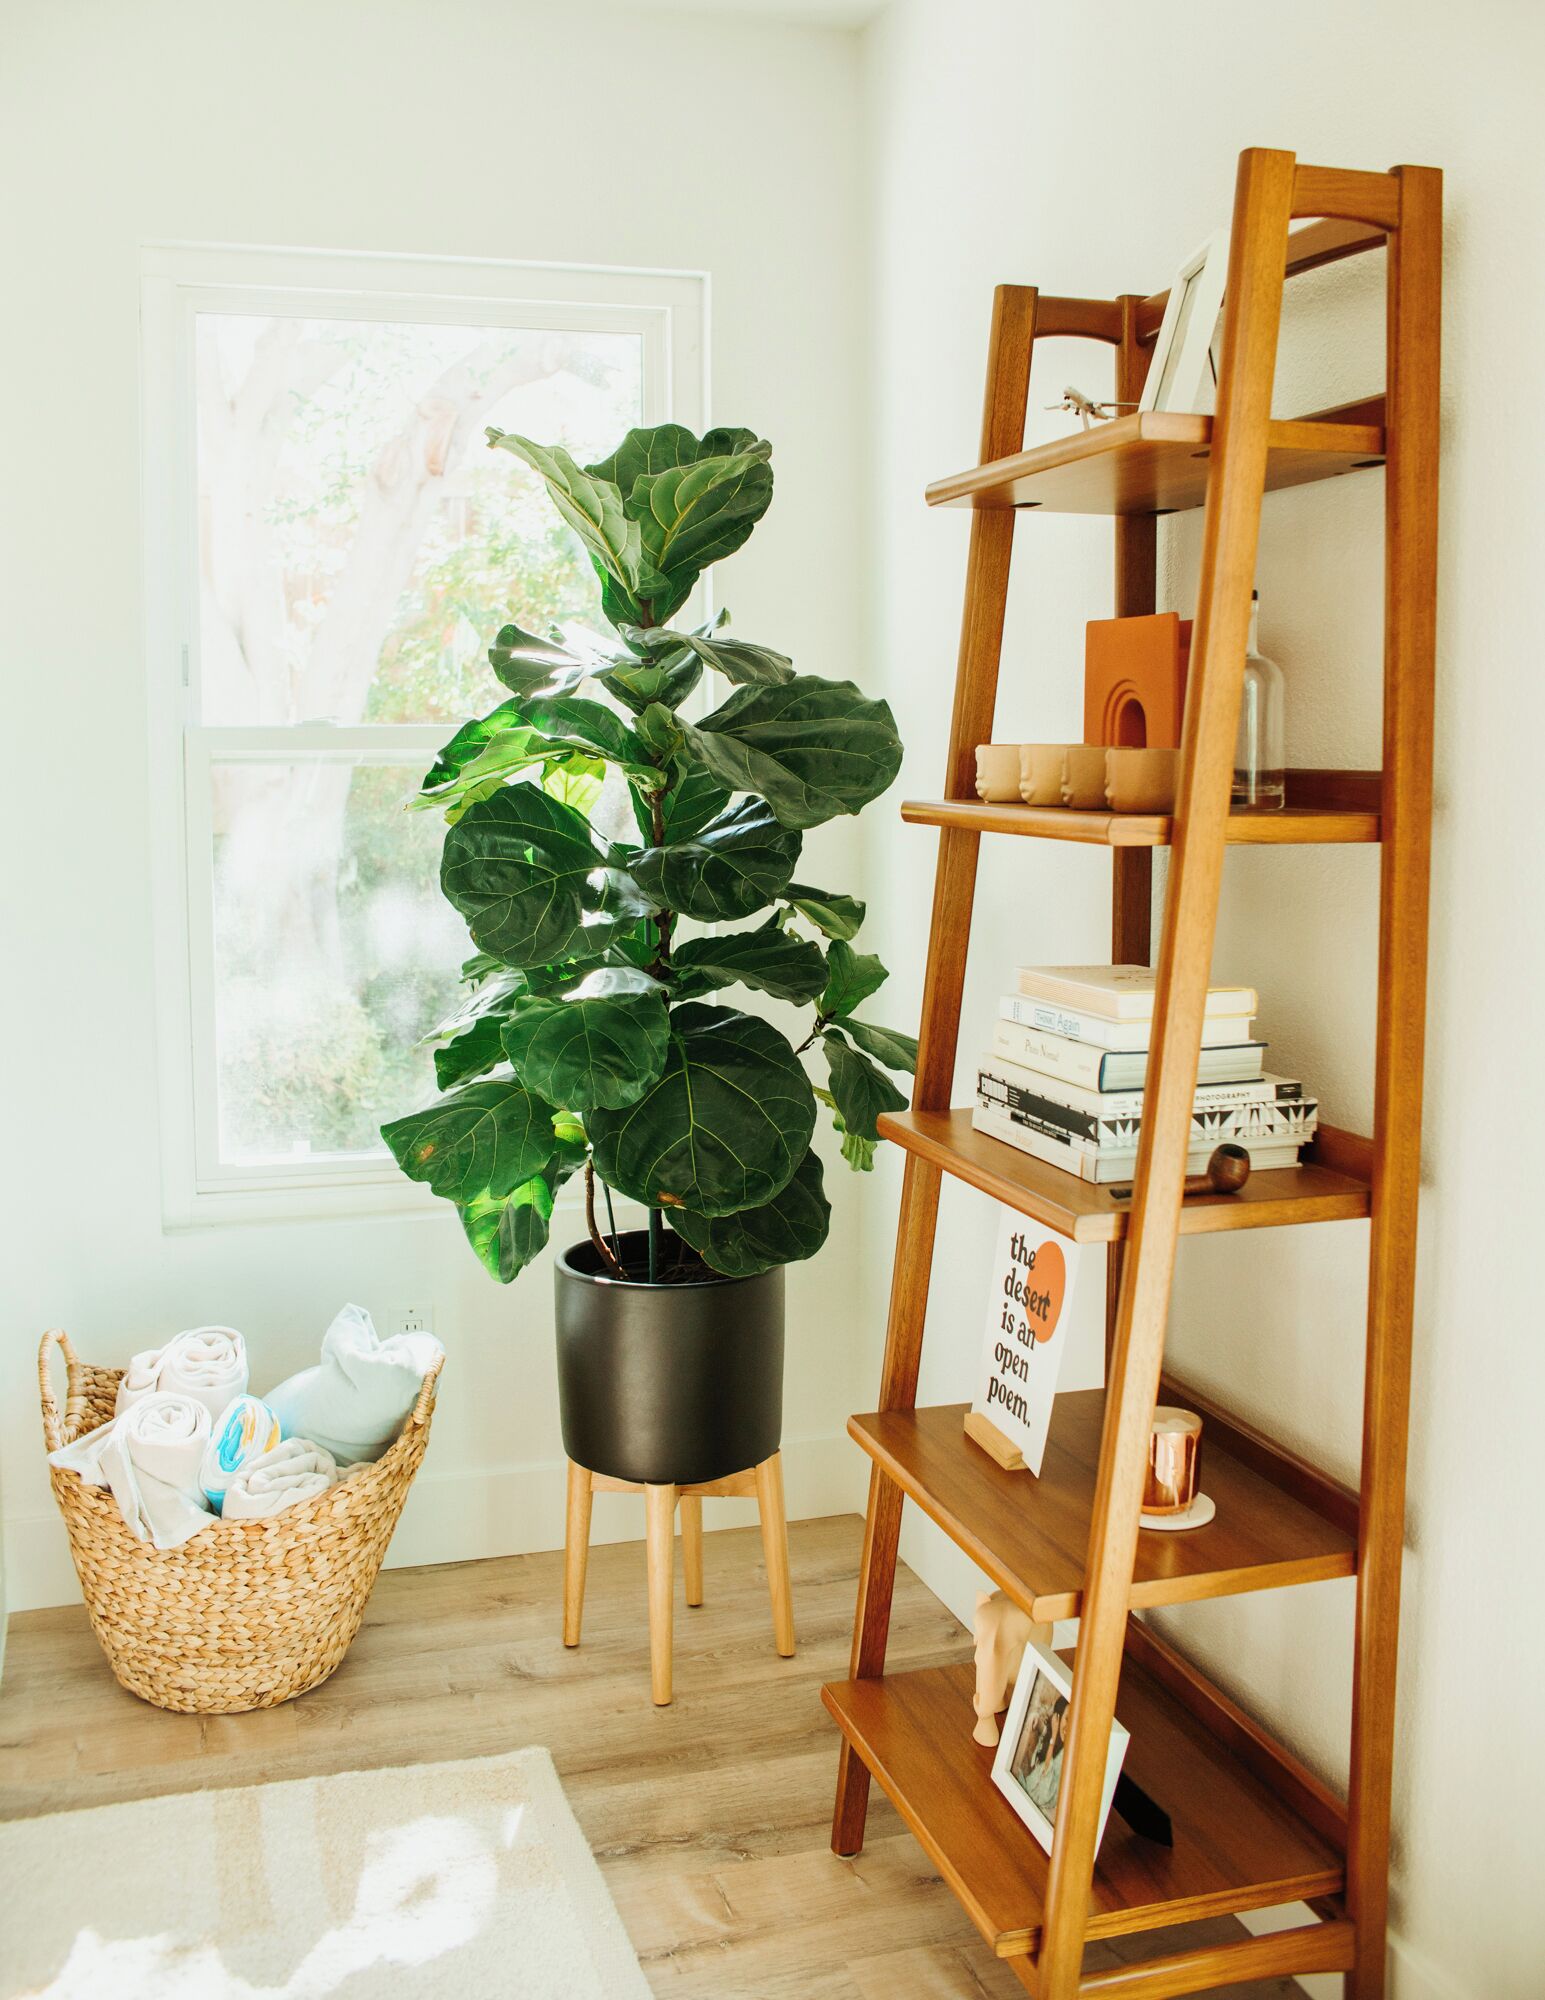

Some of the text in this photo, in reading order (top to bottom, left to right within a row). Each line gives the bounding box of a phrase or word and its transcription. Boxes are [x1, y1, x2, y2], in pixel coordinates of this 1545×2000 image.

[1057, 1013, 1080, 1035] Again
[1195, 1092, 1251, 1101] PHOTOGRAPHY
[1010, 1232, 1036, 1271] the
[1004, 1267, 1051, 1322] desert
[1000, 1302, 1036, 1350] is an
[994, 1342, 1029, 1383] open
[987, 1376, 1030, 1428] poem.
